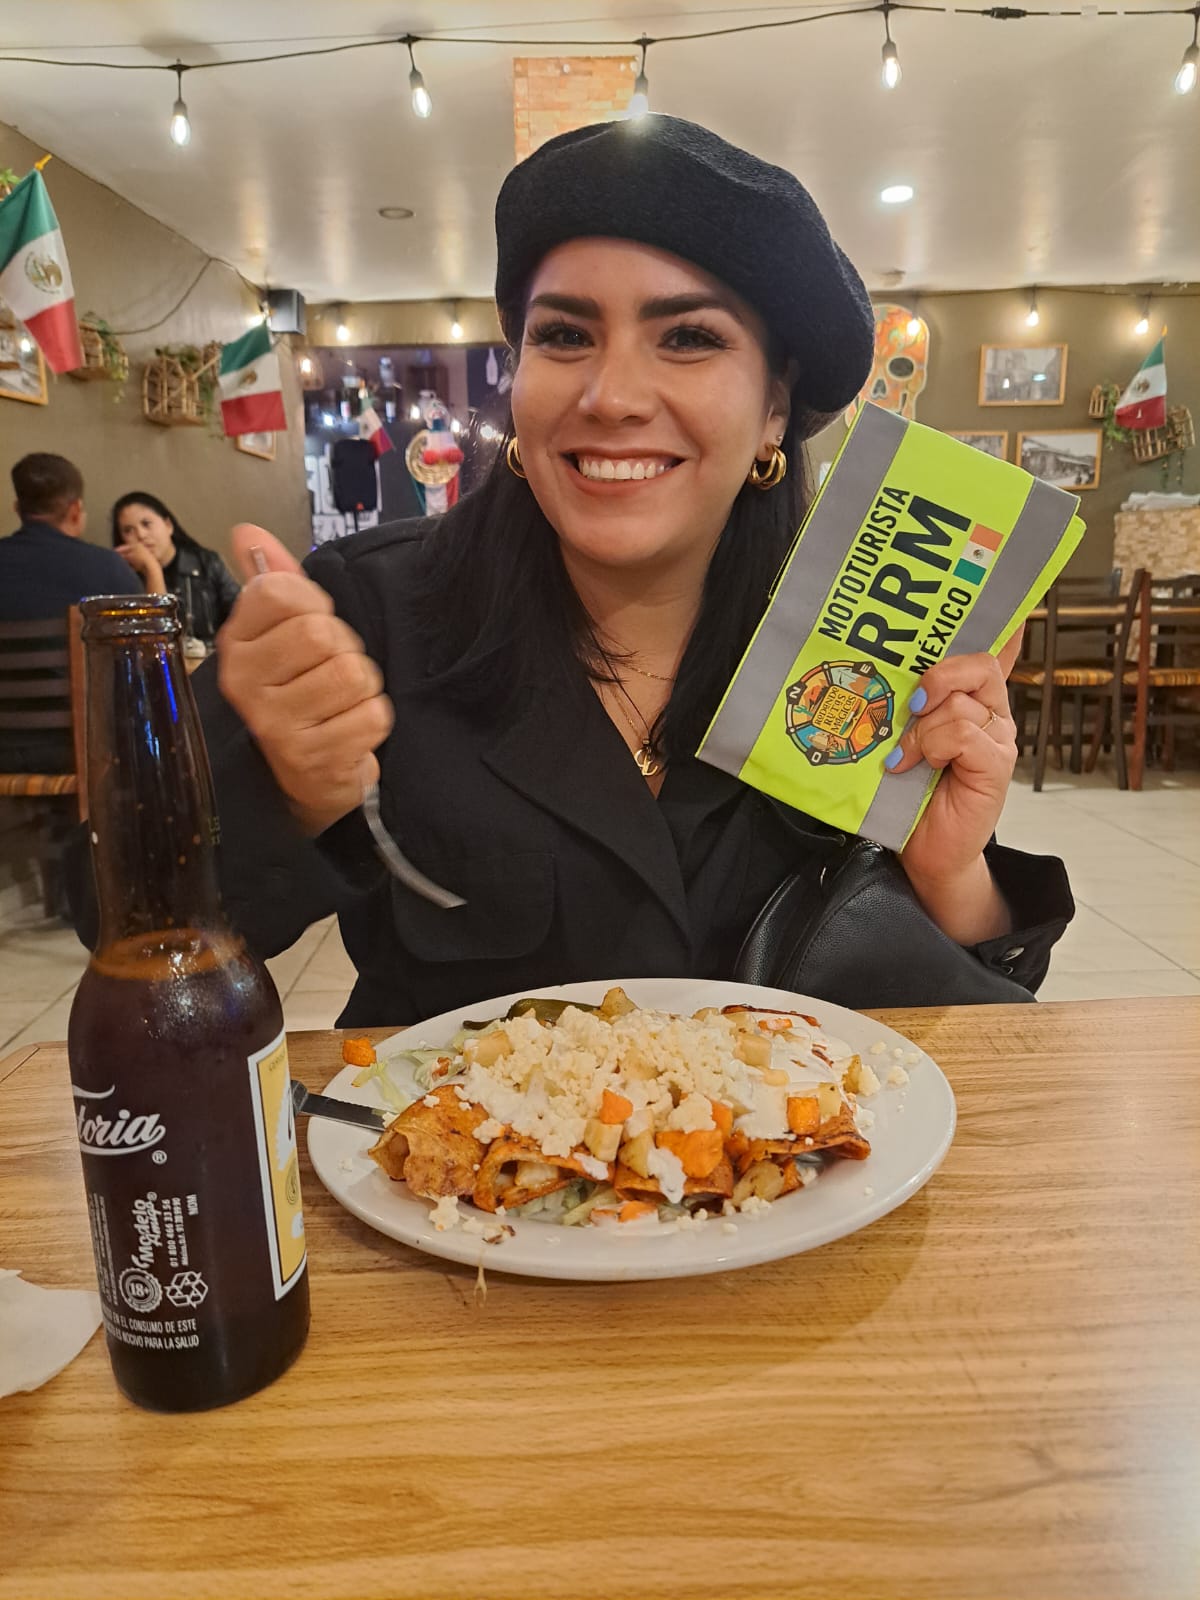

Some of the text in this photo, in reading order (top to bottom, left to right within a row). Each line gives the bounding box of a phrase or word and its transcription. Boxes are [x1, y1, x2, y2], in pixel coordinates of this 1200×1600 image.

[819, 486, 910, 641] MOTOTURISTA
[845, 495, 971, 667] RRM
[908, 587, 972, 676] MÉXICO
[131, 1199, 155, 1269] Modelo
[129, 1318, 163, 1334] CONSUMO
[165, 1320, 176, 1334] DE
[177, 1318, 197, 1333] ESTE
[144, 1336, 163, 1349] PARA
[164, 1337, 175, 1350] LA
[175, 1334, 200, 1350] SALUD
